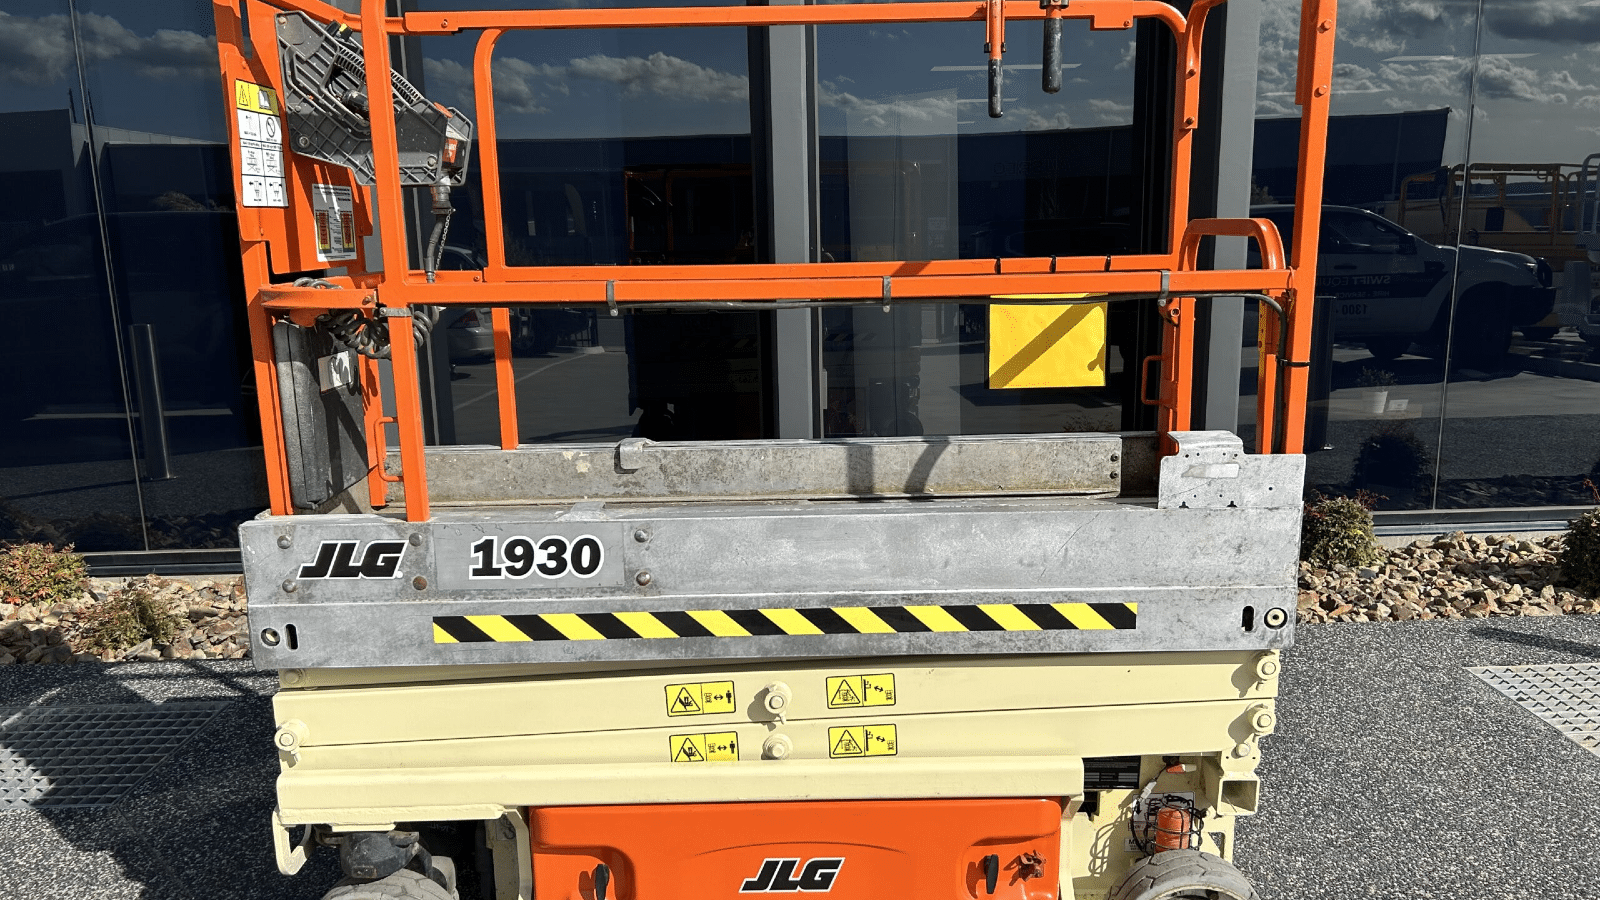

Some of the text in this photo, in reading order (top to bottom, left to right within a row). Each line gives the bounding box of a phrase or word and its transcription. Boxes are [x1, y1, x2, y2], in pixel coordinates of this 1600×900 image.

[297, 540, 409, 580] JLG
[469, 535, 604, 580] 1930
[739, 857, 845, 893] JLG
